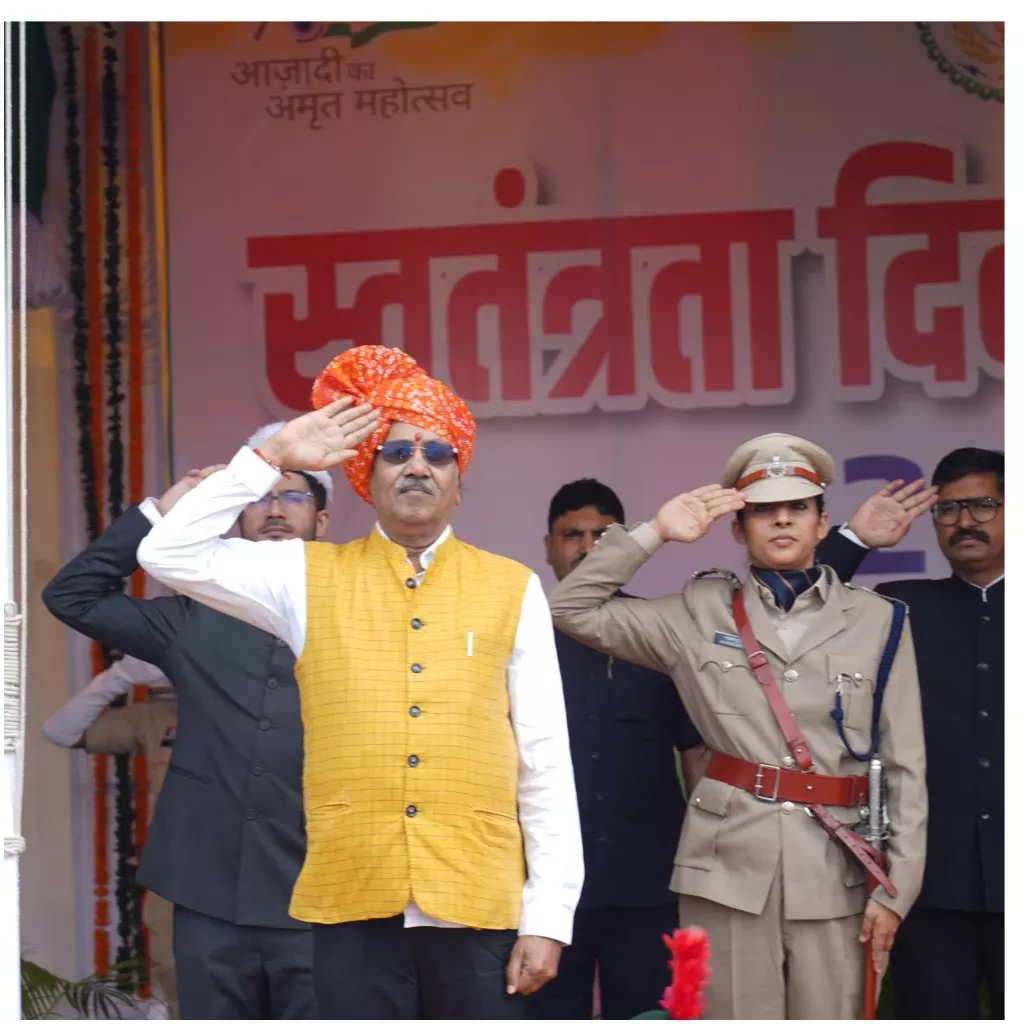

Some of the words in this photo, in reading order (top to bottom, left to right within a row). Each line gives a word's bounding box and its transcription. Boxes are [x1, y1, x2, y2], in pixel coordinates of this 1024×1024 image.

[231, 46, 344, 91] आज़ादी
[347, 61, 376, 81] का
[265, 91, 344, 131] अमृत
[353, 77, 476, 120] महोत्सव
[247, 167, 795, 413] स्वतंत्रता
